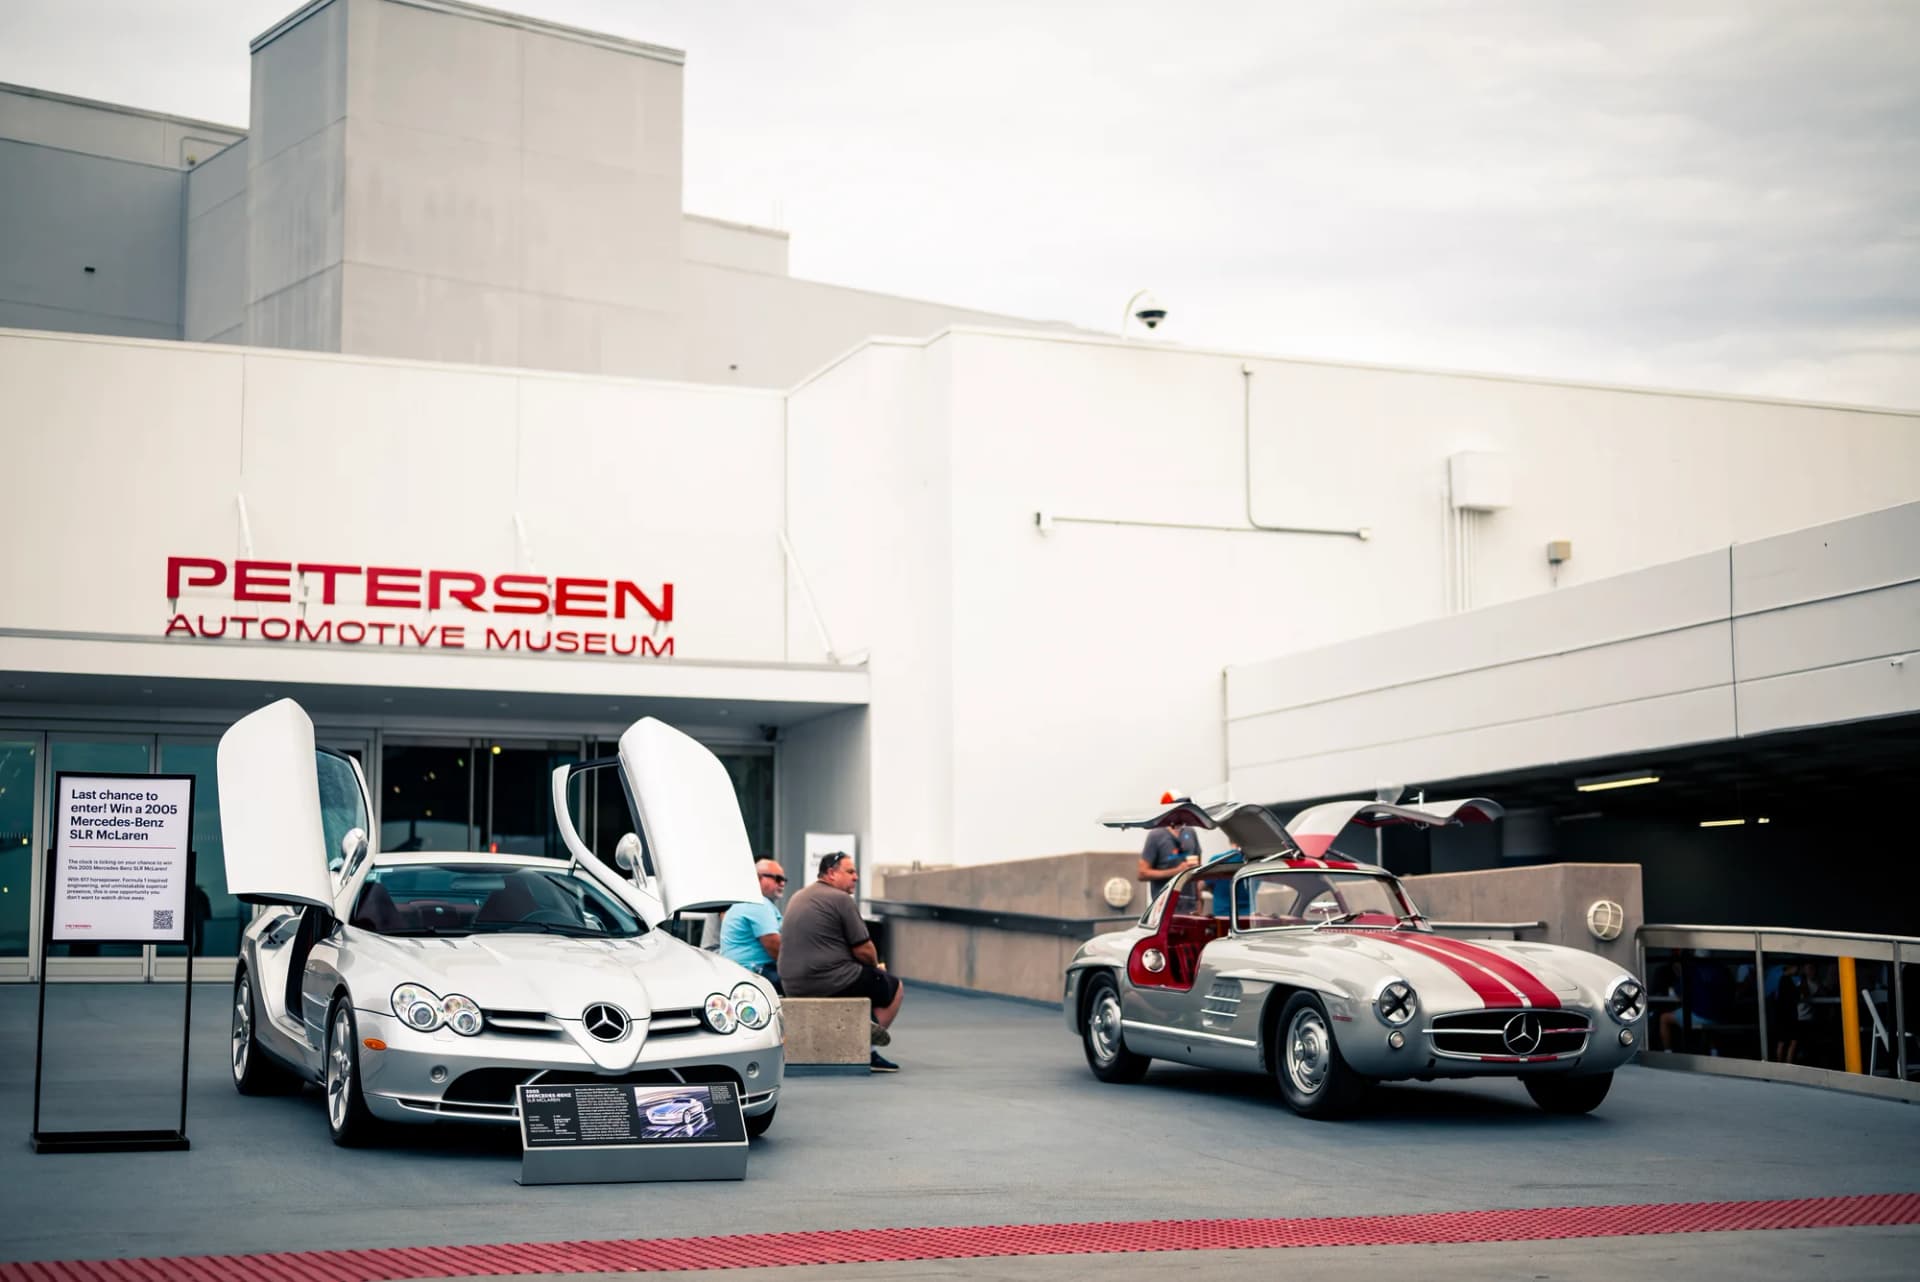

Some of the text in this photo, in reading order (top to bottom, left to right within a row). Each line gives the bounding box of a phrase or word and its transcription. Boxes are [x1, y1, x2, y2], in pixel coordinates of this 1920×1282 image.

[167, 556, 673, 622] PETERSEN
[165, 613, 674, 657] AUTOMOTIVE MUSEUM
[72, 789, 158, 801] Last chance to
[71, 803, 177, 815] enter! Win a 2005
[70, 816, 165, 828] Mercedes-Benz
[70, 829, 149, 841] SLR McLaren
